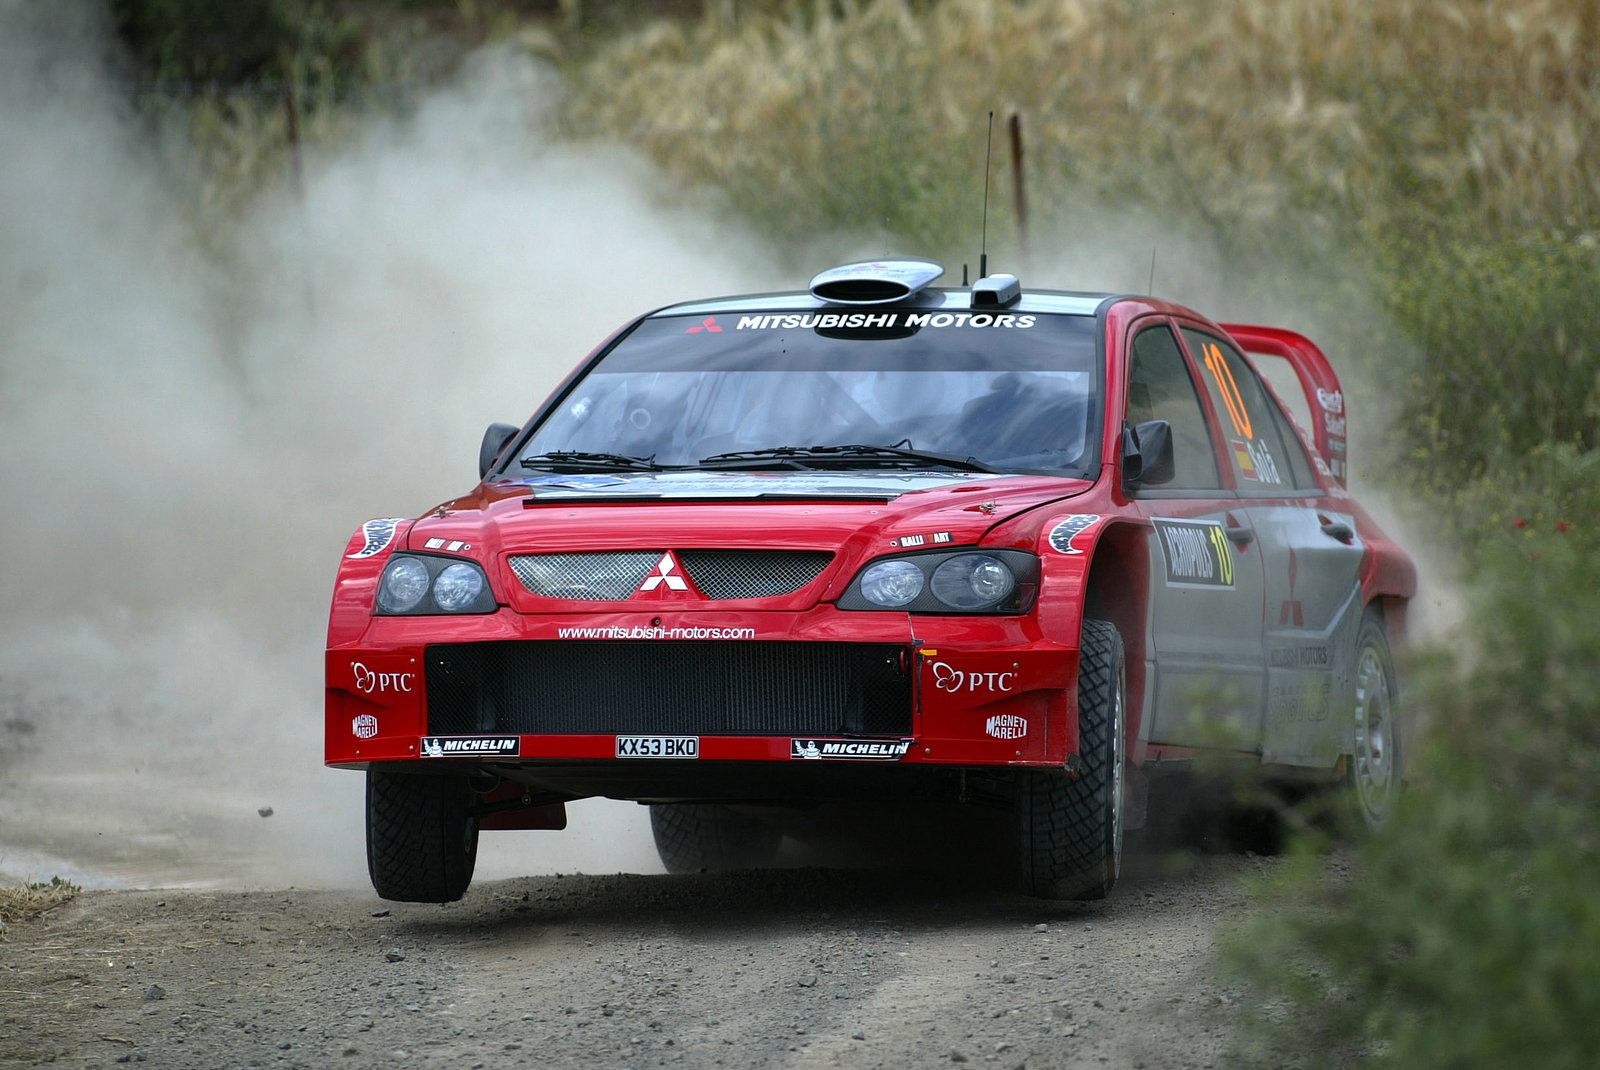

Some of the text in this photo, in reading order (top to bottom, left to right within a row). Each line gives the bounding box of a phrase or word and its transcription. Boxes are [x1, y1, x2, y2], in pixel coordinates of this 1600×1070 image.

[737, 312, 1037, 330] MITSUBISHI MOTORS
[1200, 342, 1254, 441] 10
[1162, 525, 1232, 585] ACROPOLIS 10
[557, 625, 756, 640] www.mitsubishi-motors.com
[379, 673, 413, 692] PTC
[969, 672, 1013, 692] PTC
[443, 739, 516, 751] MICHELIN
[617, 738, 661, 756] KX53
[822, 742, 910, 755] MICHELIN
